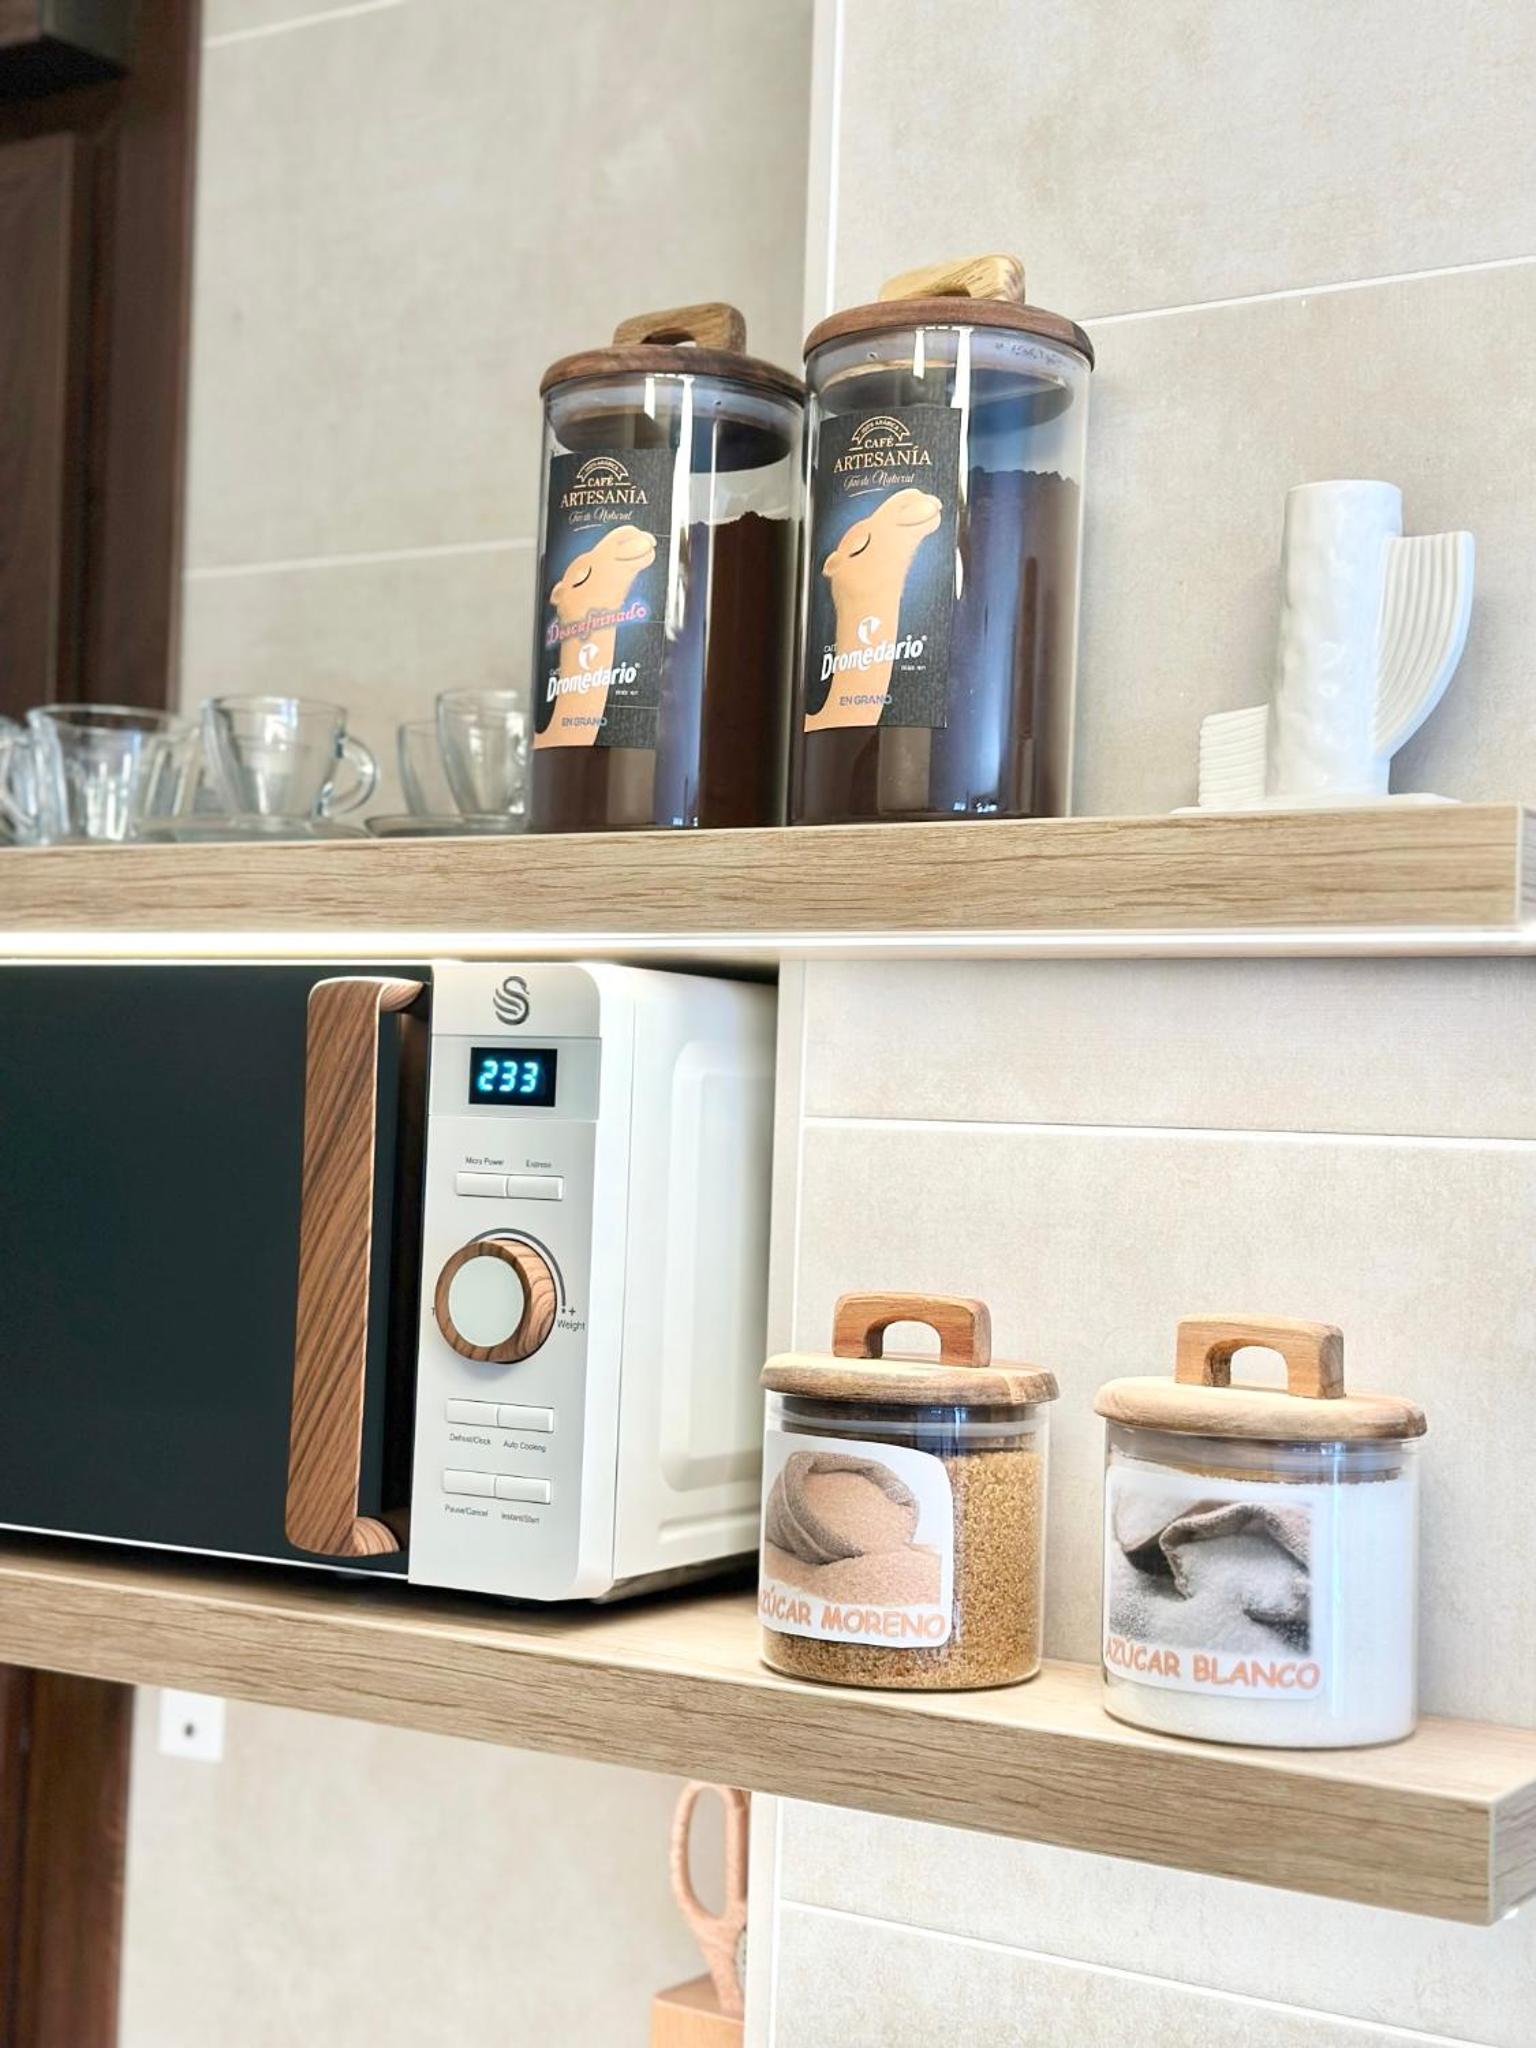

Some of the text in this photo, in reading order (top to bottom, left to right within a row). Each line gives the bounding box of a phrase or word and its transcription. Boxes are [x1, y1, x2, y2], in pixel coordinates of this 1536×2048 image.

[864, 435, 894, 449] CAFÉ
[834, 446, 932, 473] ARTESANÍA
[587, 475, 614, 487] CAFÉ
[560, 486, 649, 508] ARTESANÍA
[840, 694, 893, 706] EN GRANO
[575, 717, 608, 727] GRANO
[477, 1059, 540, 1093] 233
[557, 1319, 586, 1332] Weight
[503, 1440, 519, 1450] Auto
[820, 1604, 946, 1640] MORENO
[1193, 1654, 1321, 1690] BLANCO
